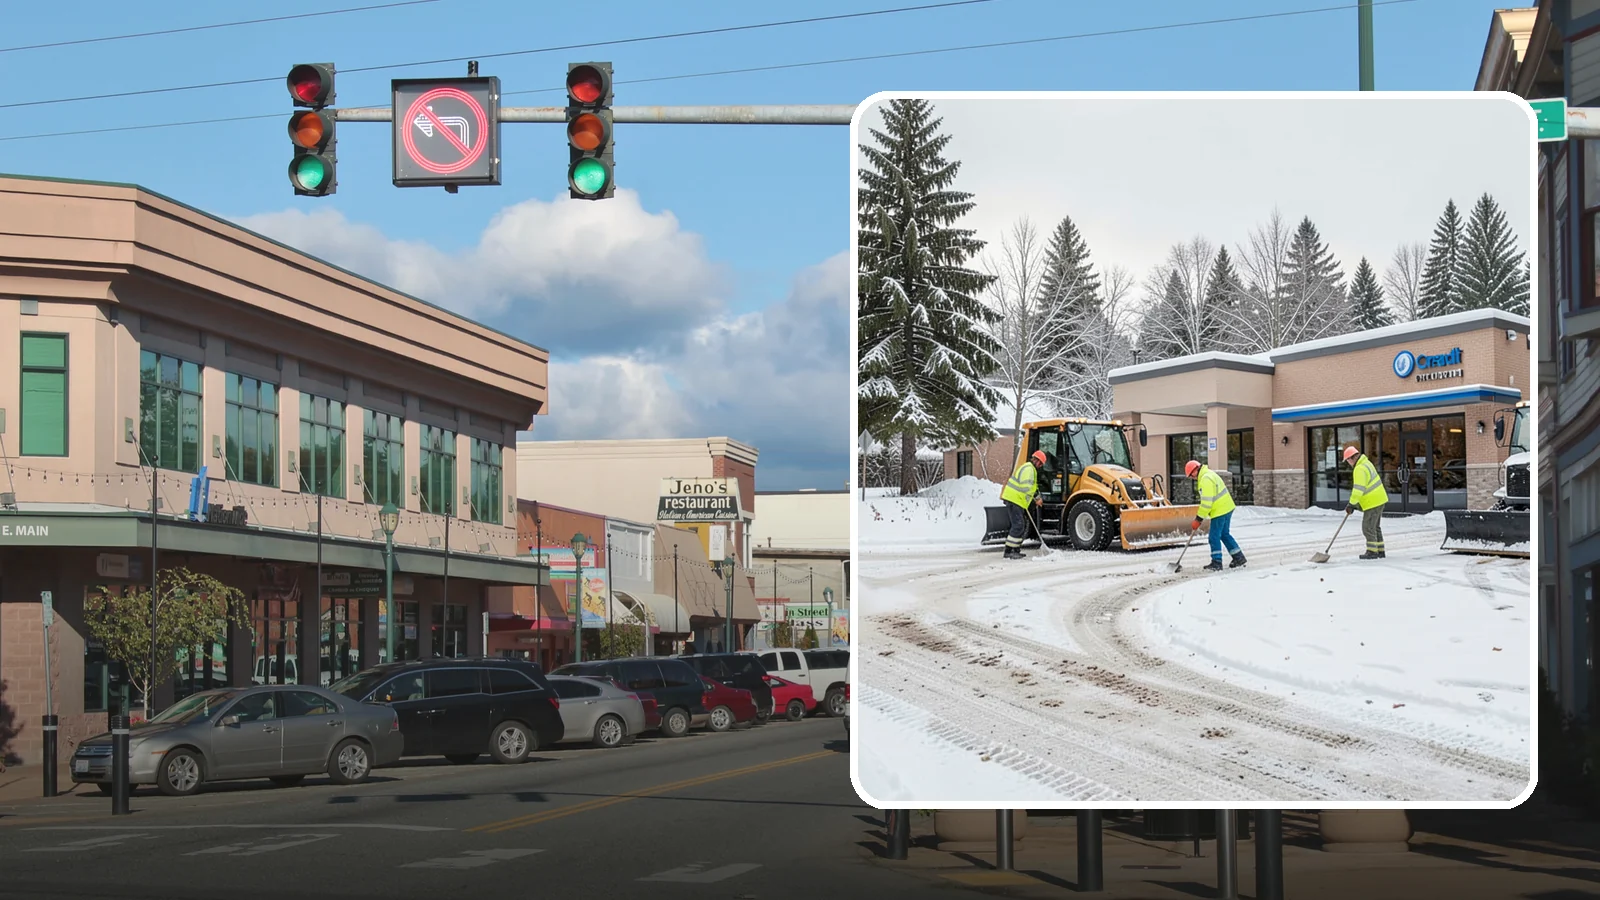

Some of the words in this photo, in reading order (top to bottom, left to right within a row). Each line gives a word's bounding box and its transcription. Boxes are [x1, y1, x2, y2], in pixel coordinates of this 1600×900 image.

[670, 480, 728, 495] Jeno's
[665, 496, 731, 509] restaurant
[658, 509, 681, 519] Italian
[686, 509, 714, 519] American
[715, 509, 738, 519] Cuisine
[2, 525, 13, 536] E.
[15, 525, 49, 536] MAIN
[797, 607, 828, 616] Street
[791, 619, 824, 627] lass
